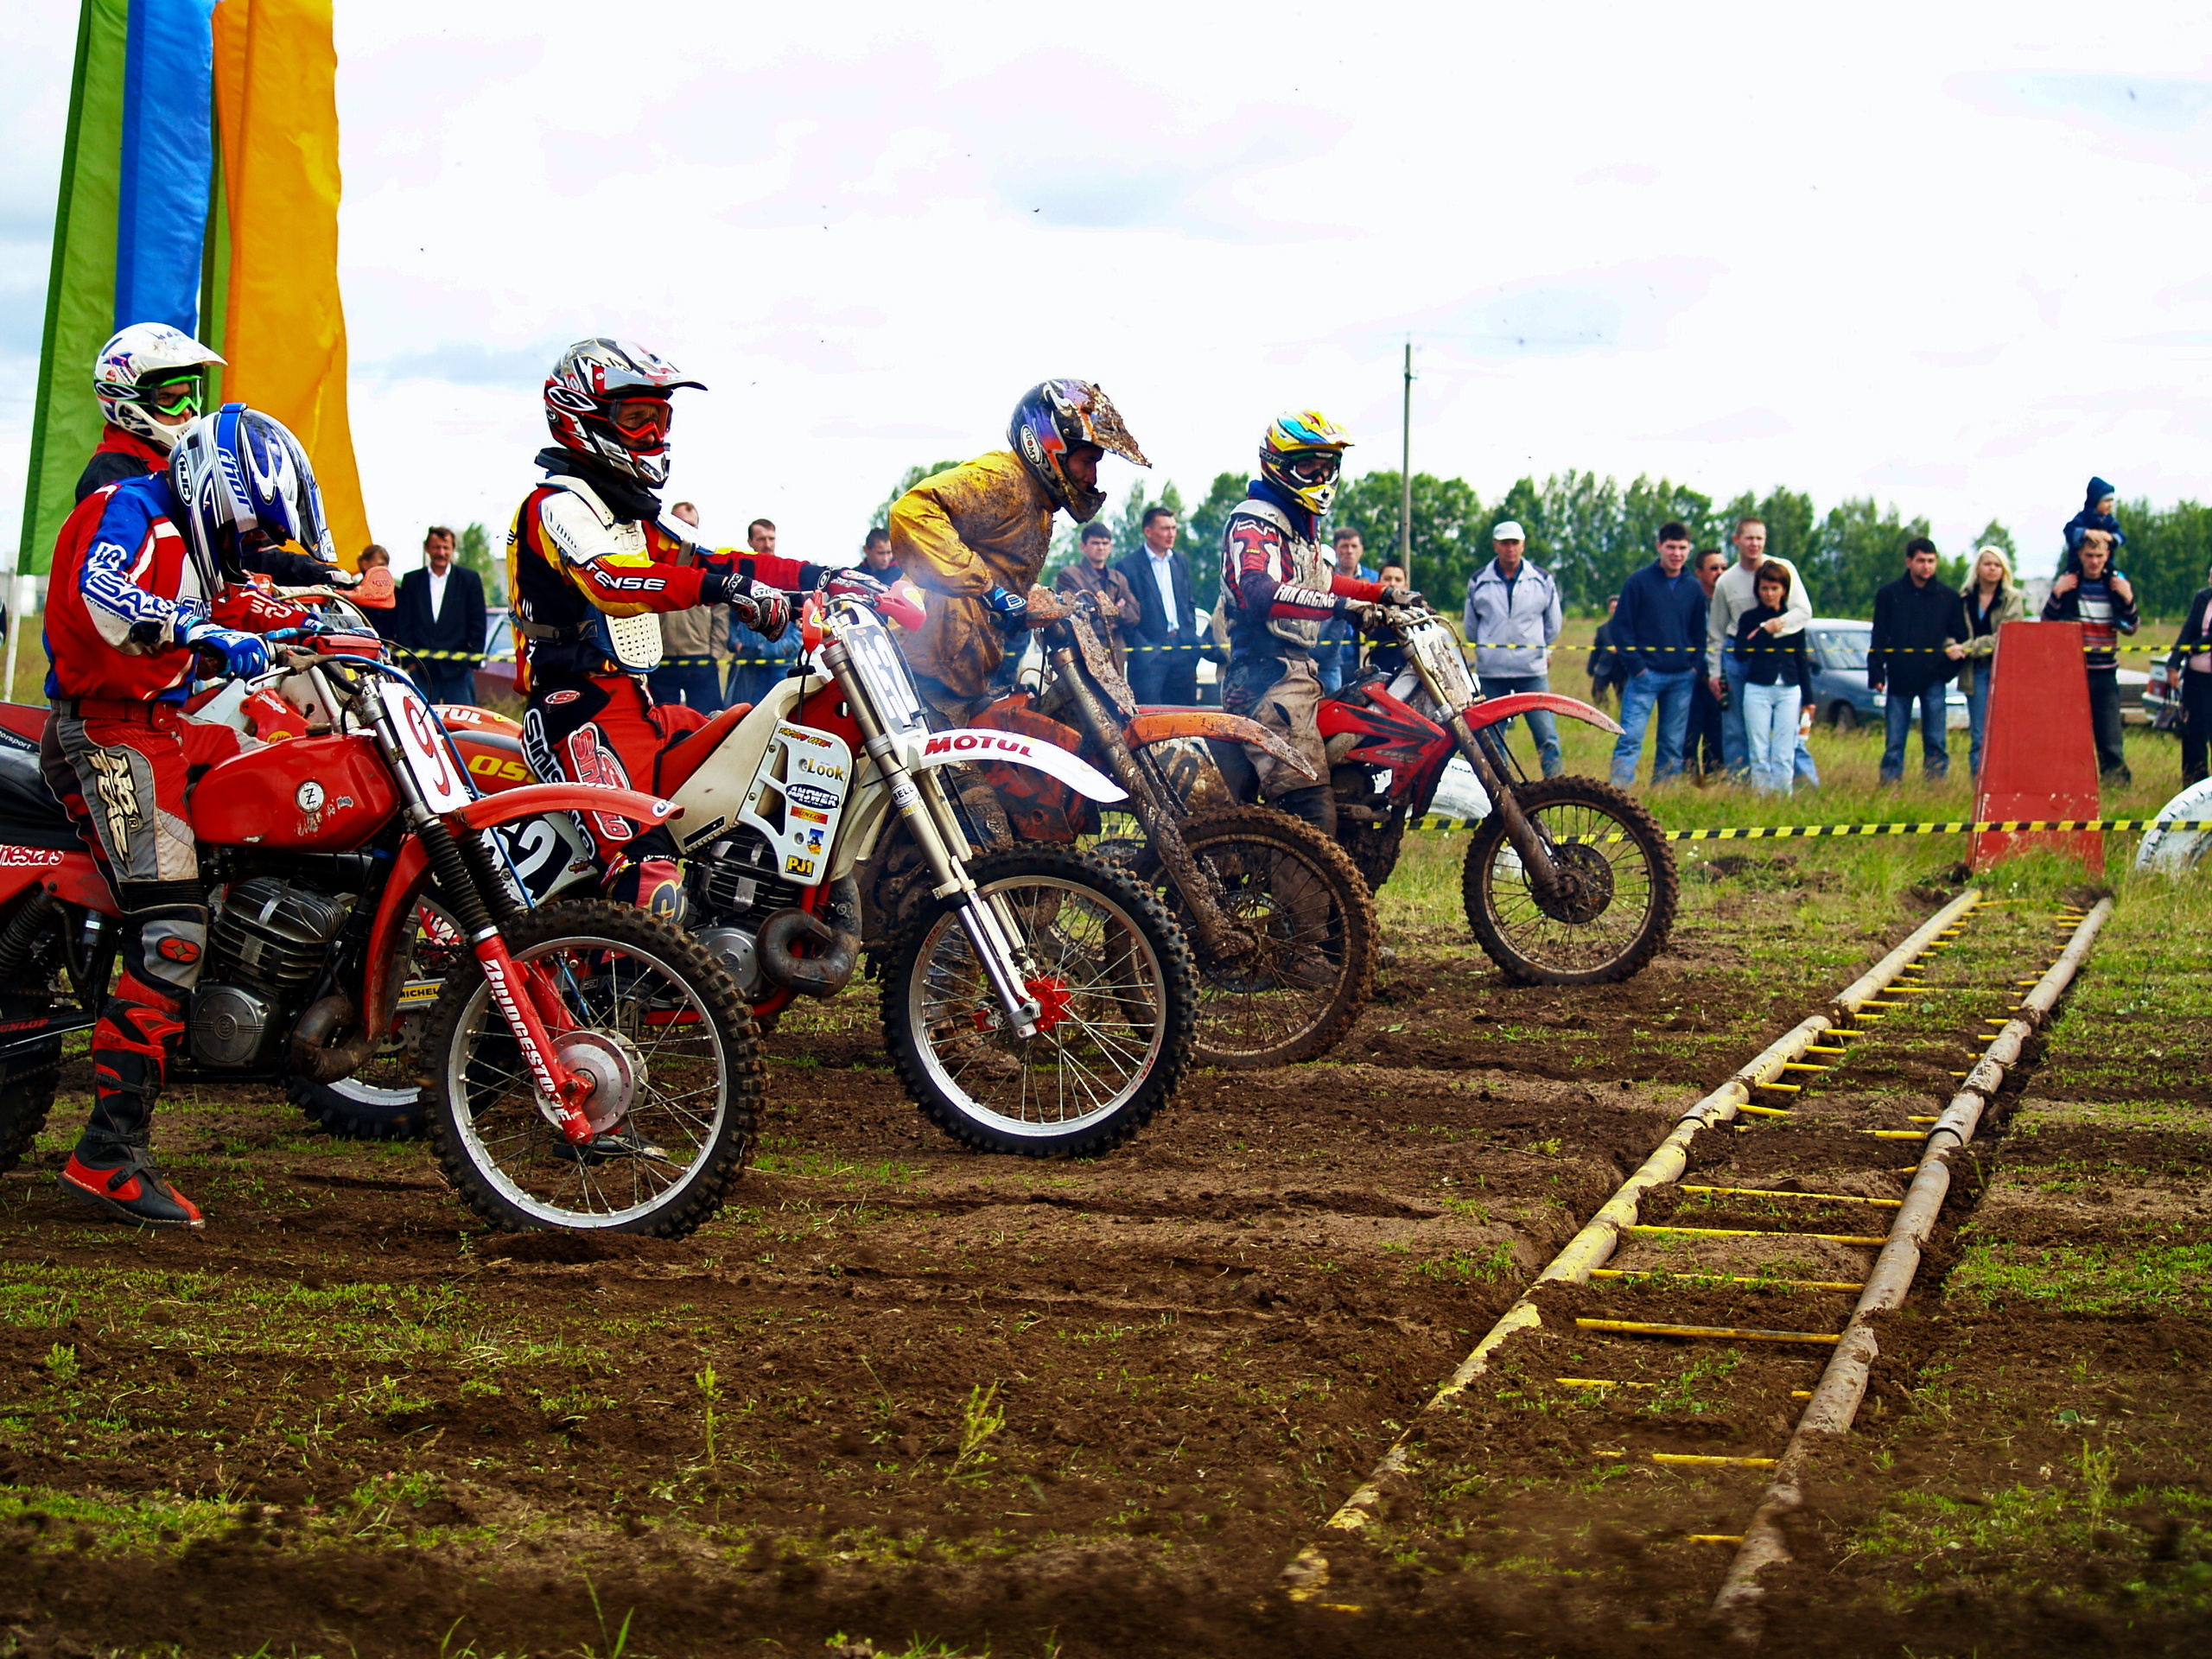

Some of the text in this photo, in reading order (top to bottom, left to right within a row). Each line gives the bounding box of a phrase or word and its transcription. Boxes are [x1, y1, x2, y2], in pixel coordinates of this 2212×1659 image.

[178, 460, 192, 501] HJC
[1273, 583, 1337, 608] FOX RACING
[0, 730, 32, 750] orsport
[403, 696, 451, 797] 9
[922, 735, 1033, 758] MOTUL
[807, 758, 844, 782] Look
[787, 785, 838, 807] ANSWER
[893, 786, 914, 801] BELL
[793, 810, 826, 822] DUNLOP
[787, 856, 814, 874] PJ1
[480, 958, 573, 1122] BRIDGESTONE
